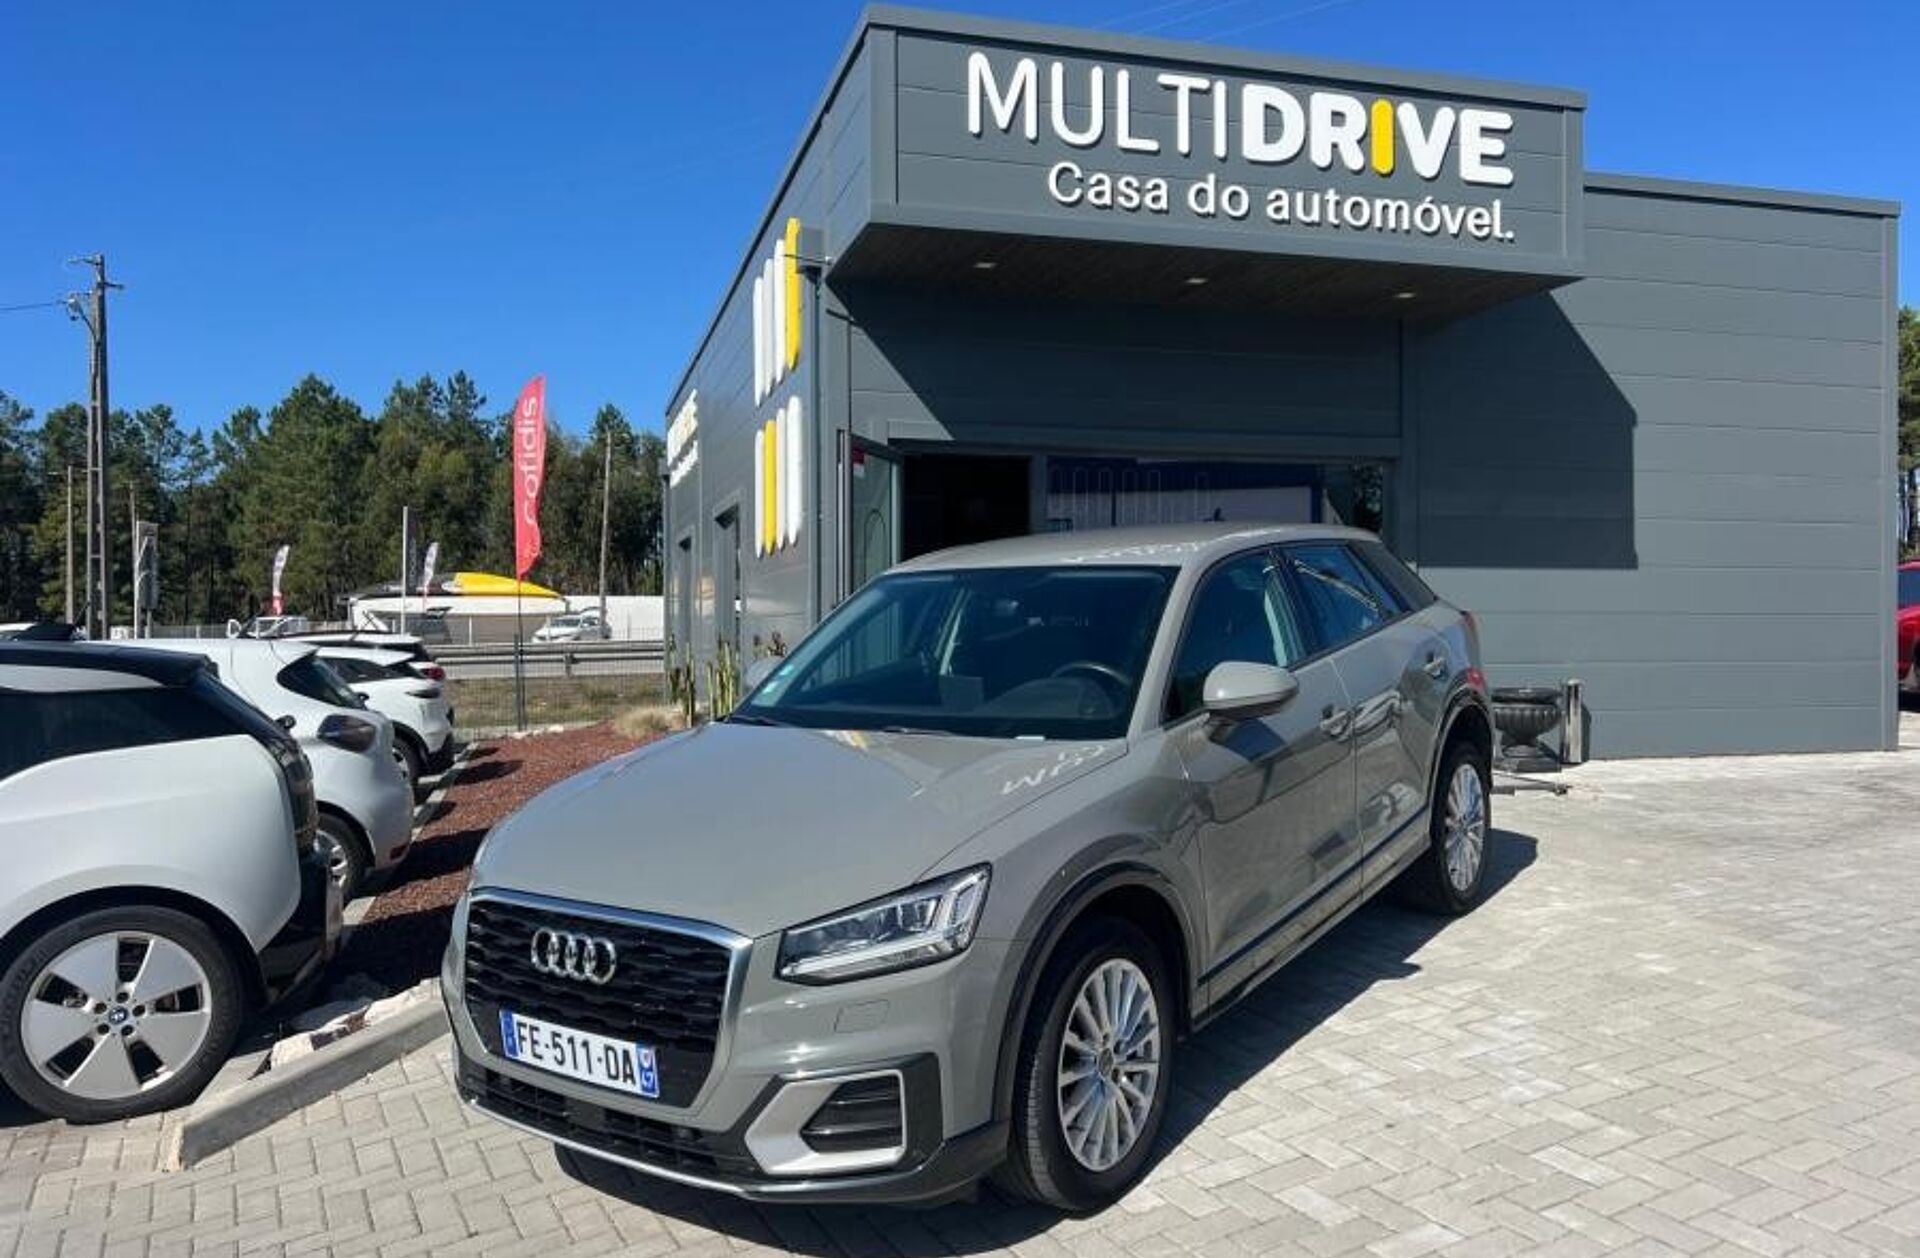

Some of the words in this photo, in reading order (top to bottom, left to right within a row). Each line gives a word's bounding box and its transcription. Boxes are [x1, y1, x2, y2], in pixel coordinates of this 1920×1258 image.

[967, 52, 1514, 186] MULTIDRIVE
[1048, 162, 1169, 211] Casa
[1187, 174, 1249, 217] do
[1265, 190, 1515, 240] automóvel.
[518, 396, 539, 525] cofidis
[516, 1021, 636, 1086] FE-511-DA
